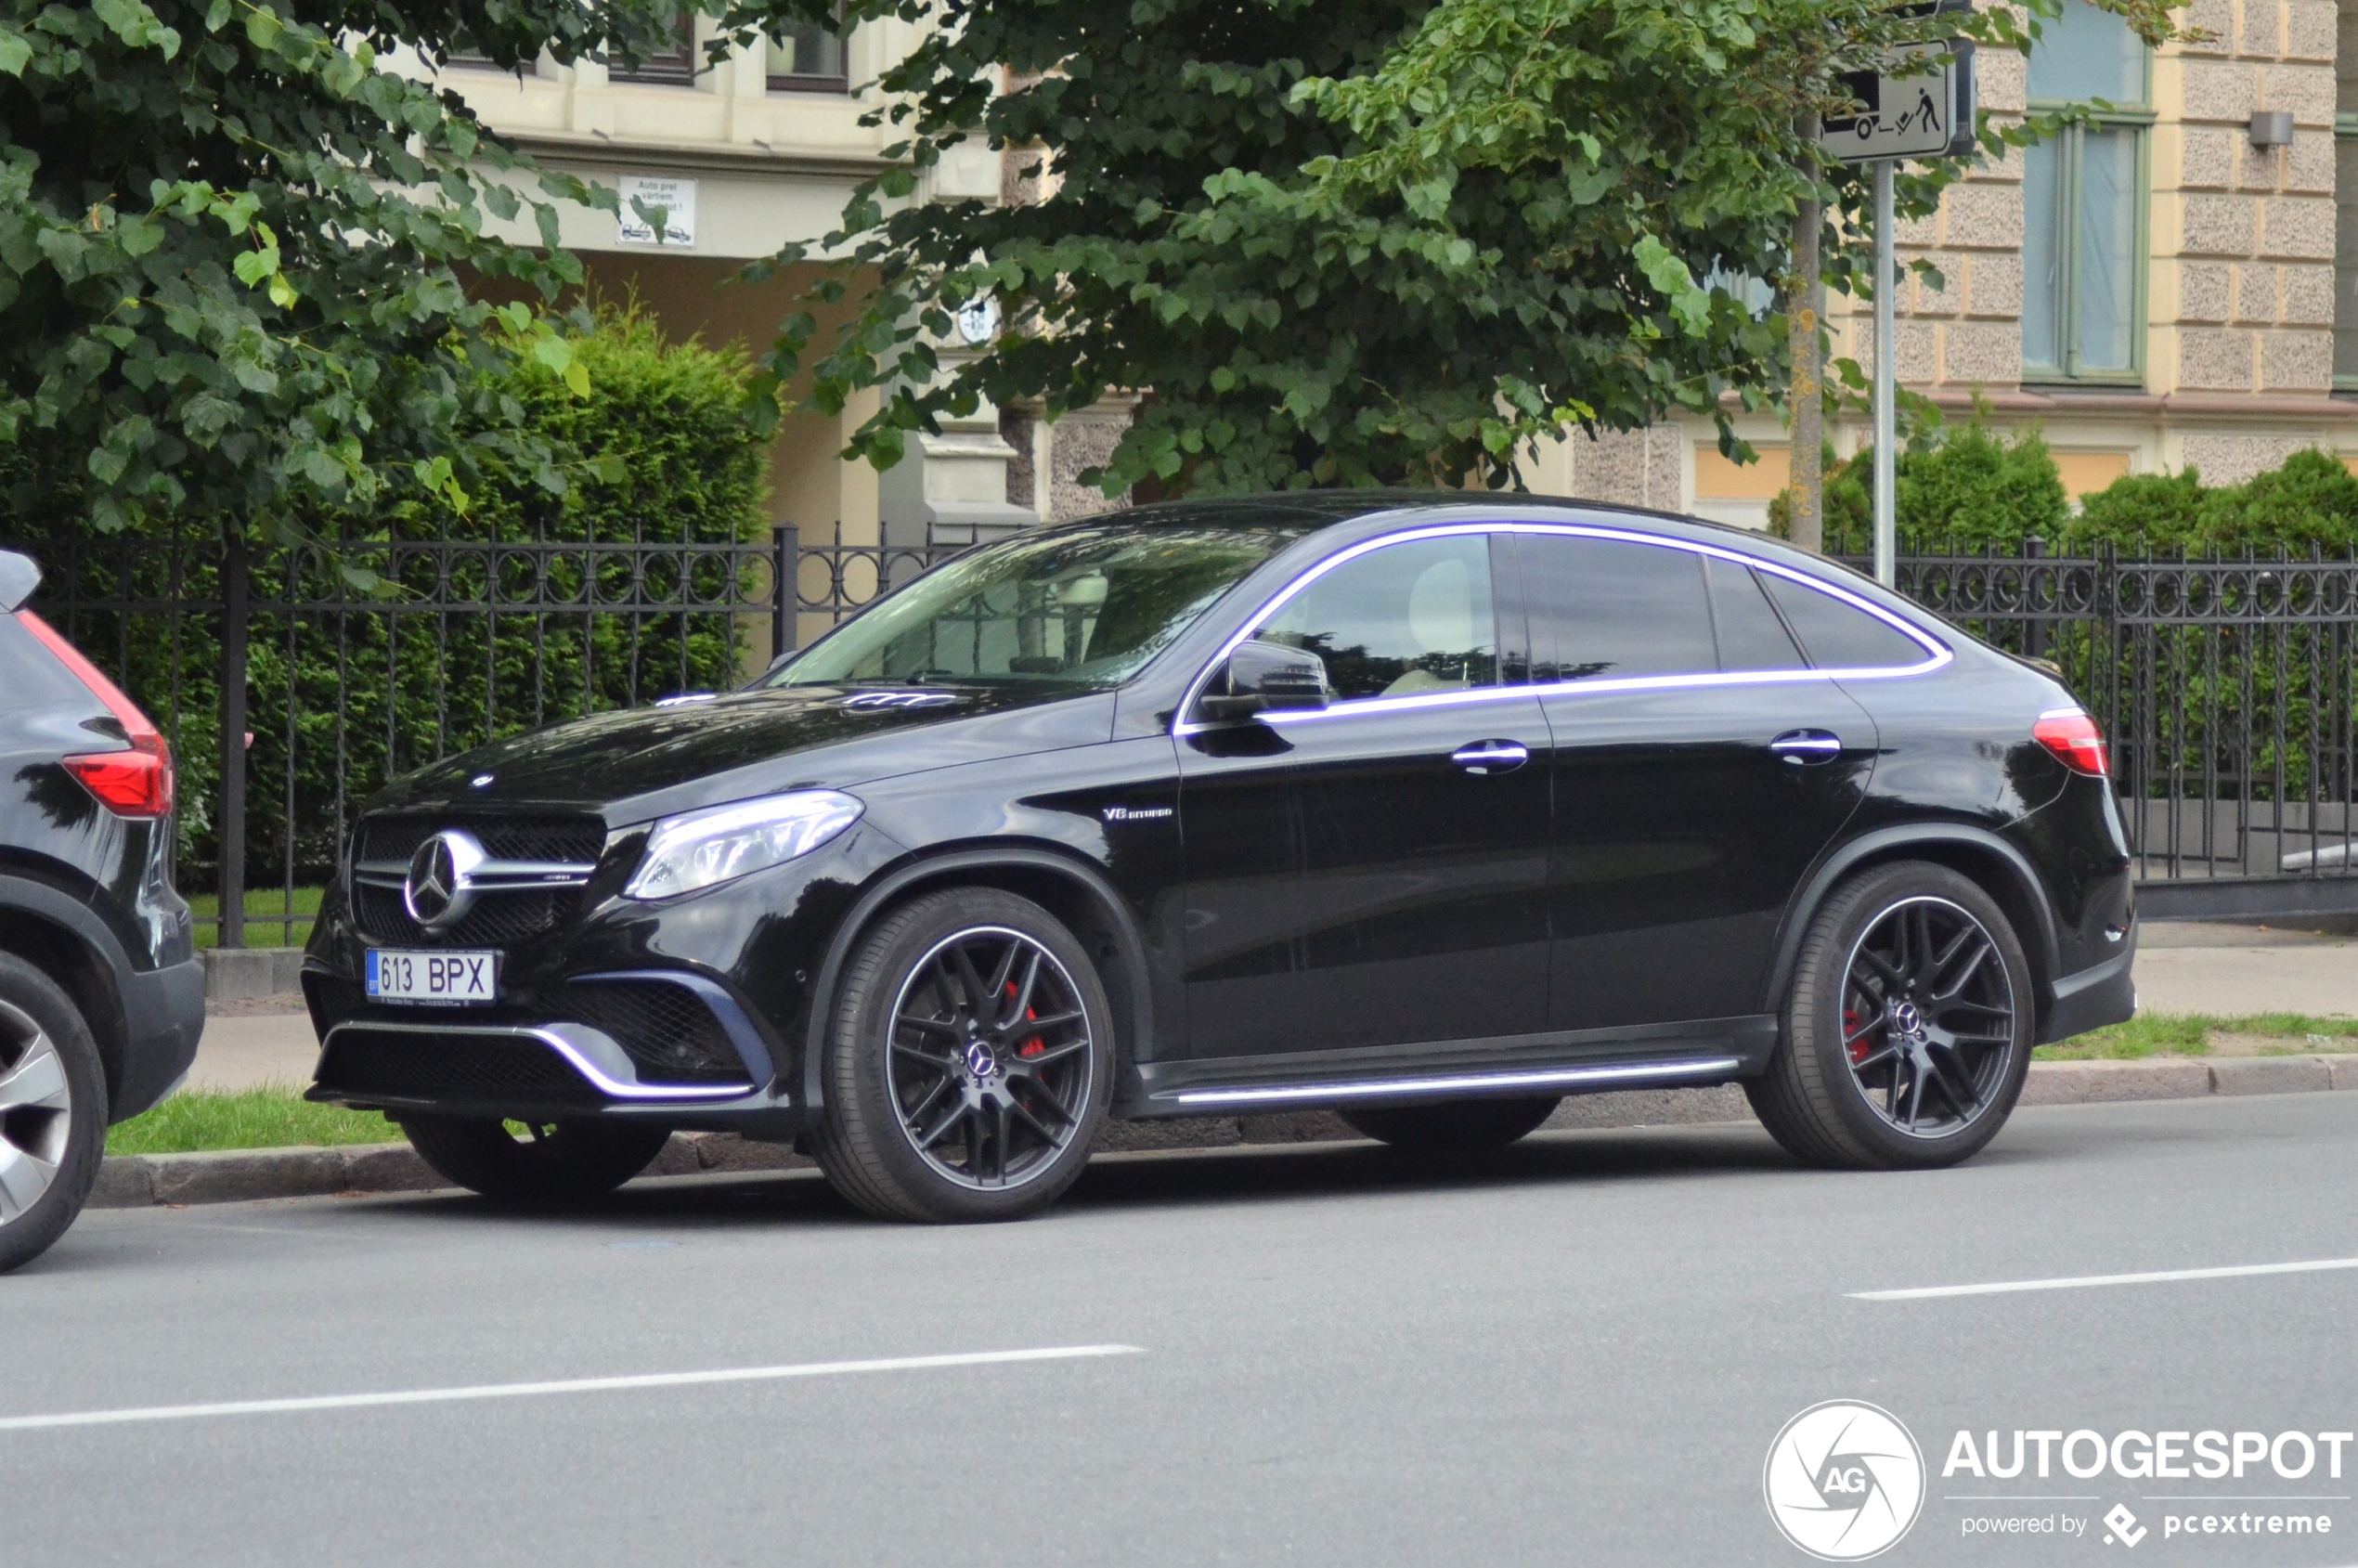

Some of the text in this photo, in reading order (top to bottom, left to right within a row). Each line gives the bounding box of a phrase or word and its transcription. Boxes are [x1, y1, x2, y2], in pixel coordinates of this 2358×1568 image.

[639, 180, 678, 192] Auto pret
[1103, 808, 1127, 821] V8
[382, 956, 485, 993] 613 BPX
